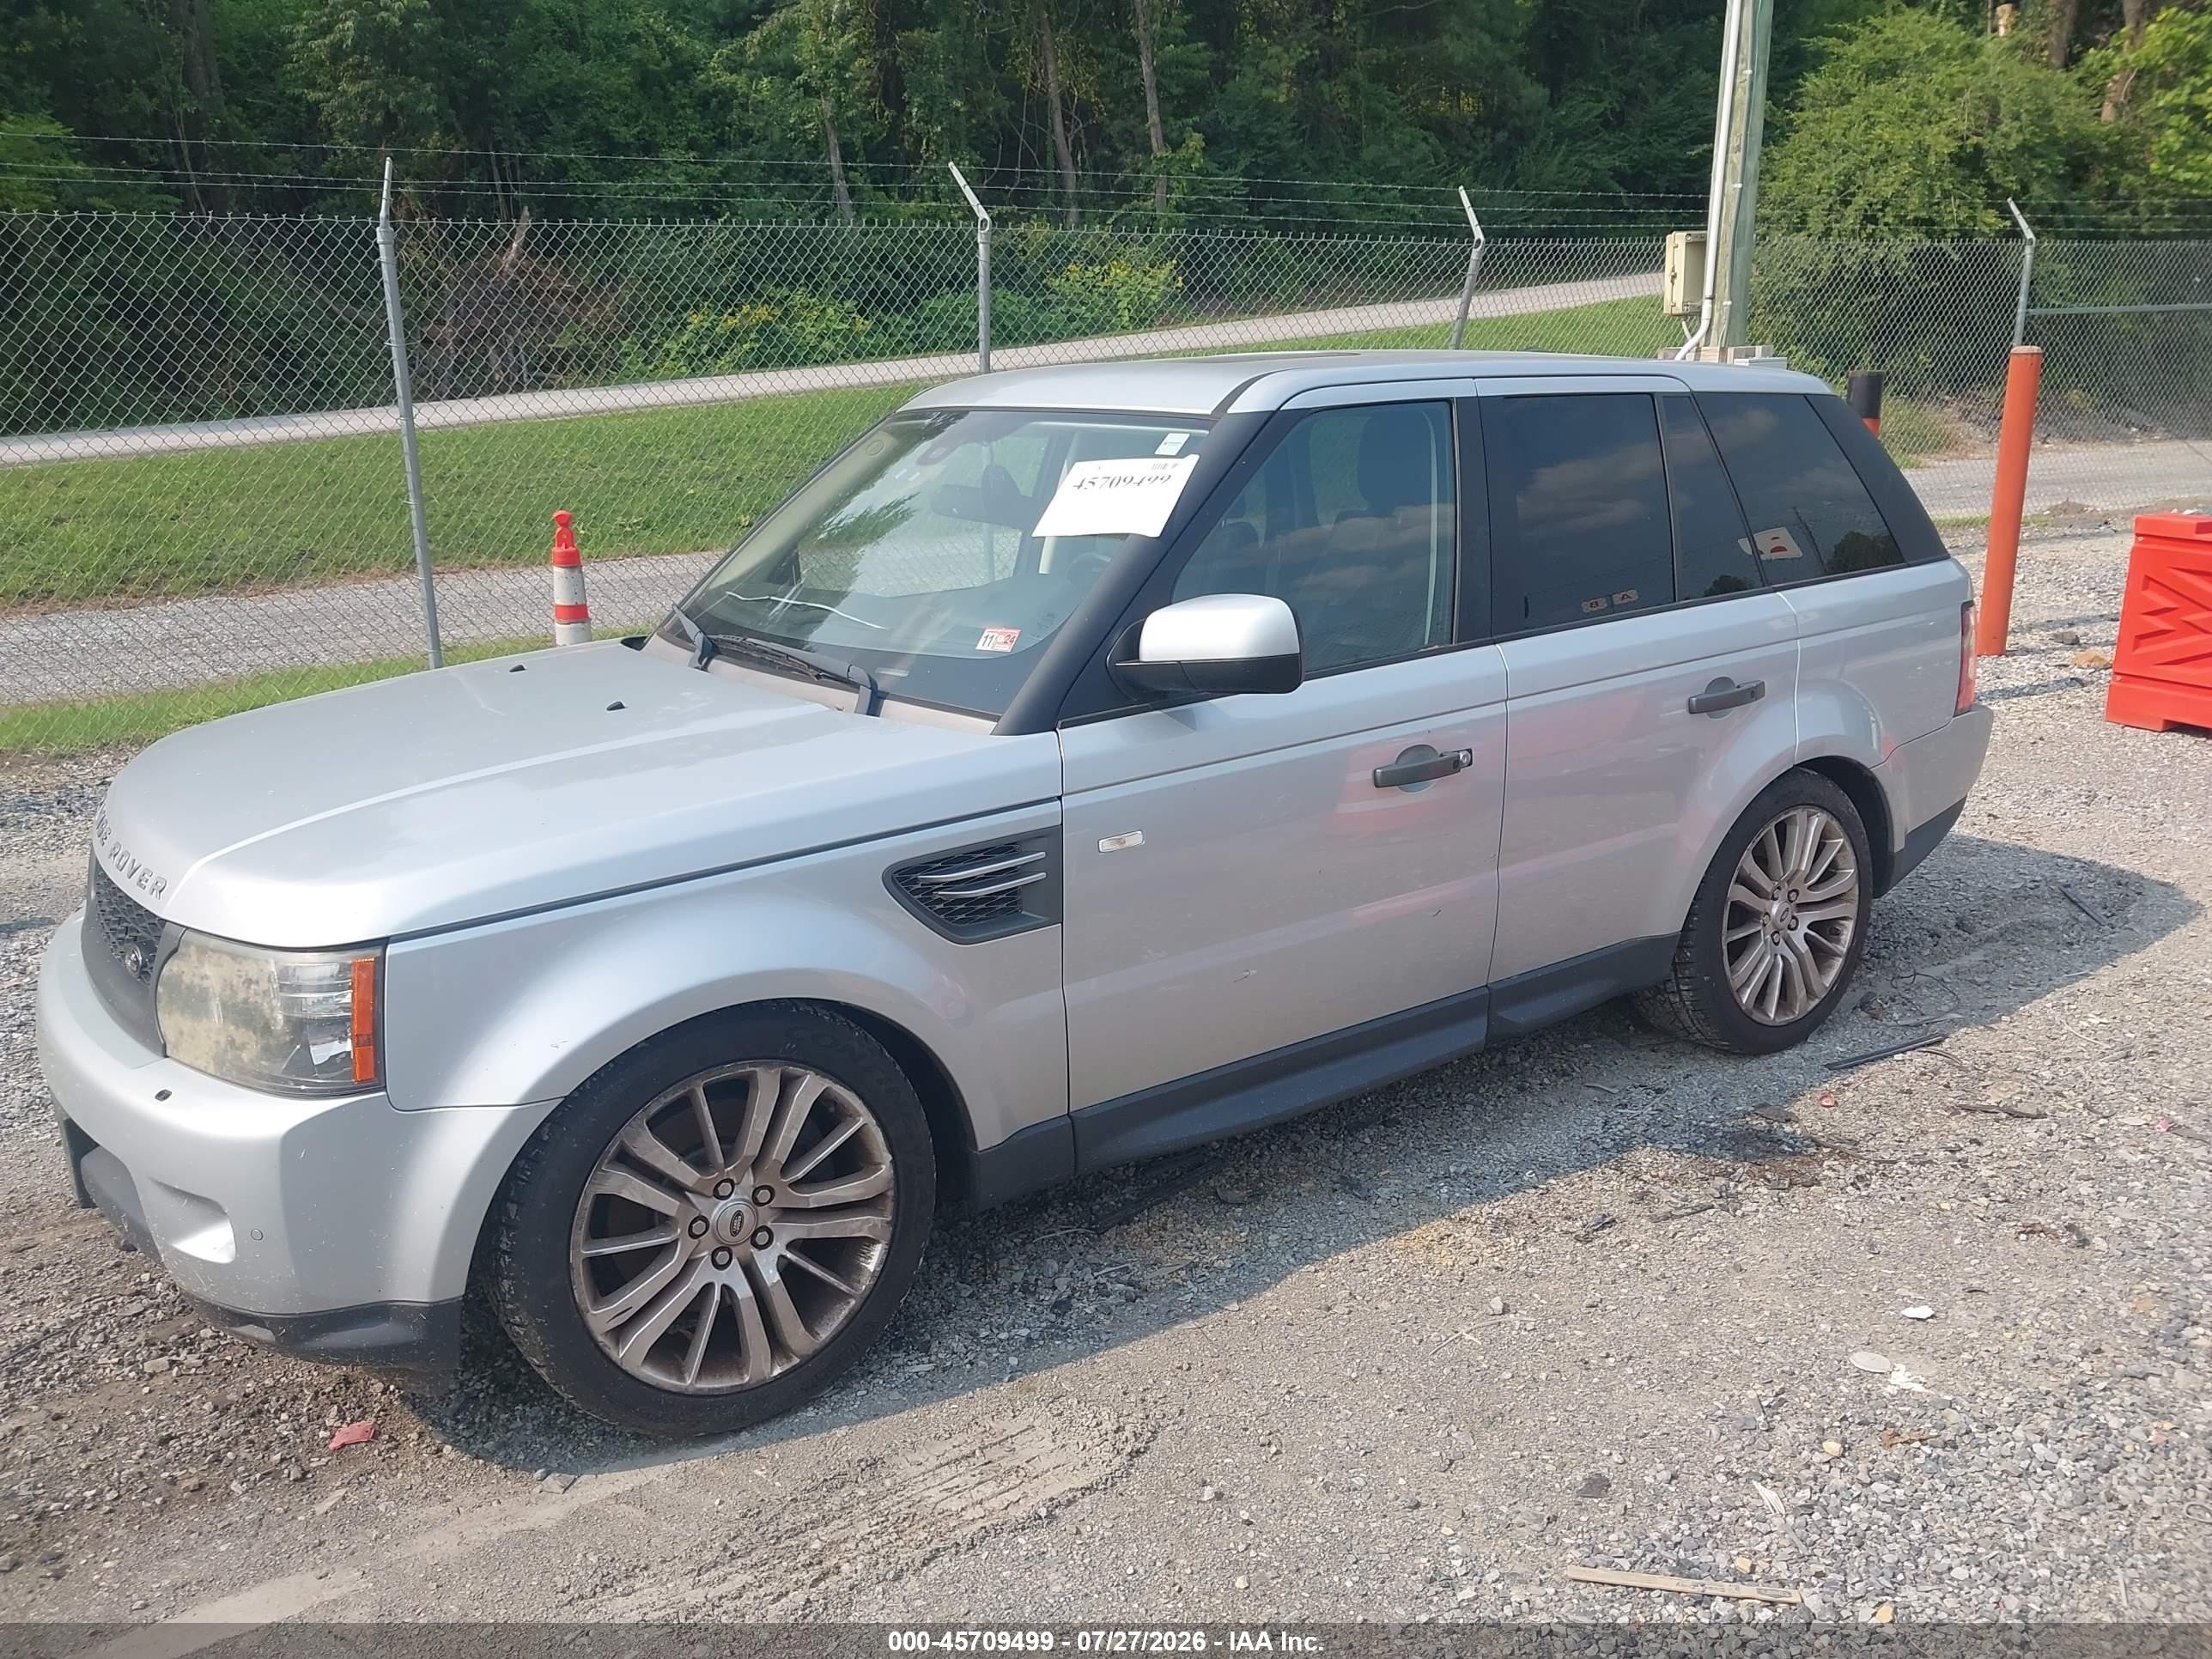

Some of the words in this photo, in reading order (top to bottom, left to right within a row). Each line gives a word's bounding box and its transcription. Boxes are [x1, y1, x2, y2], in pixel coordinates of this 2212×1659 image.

[1073, 474, 1173, 490] 45709499
[981, 634, 995, 647] 11
[1003, 634, 1017, 644] 24
[108, 841, 167, 900] ROVER
